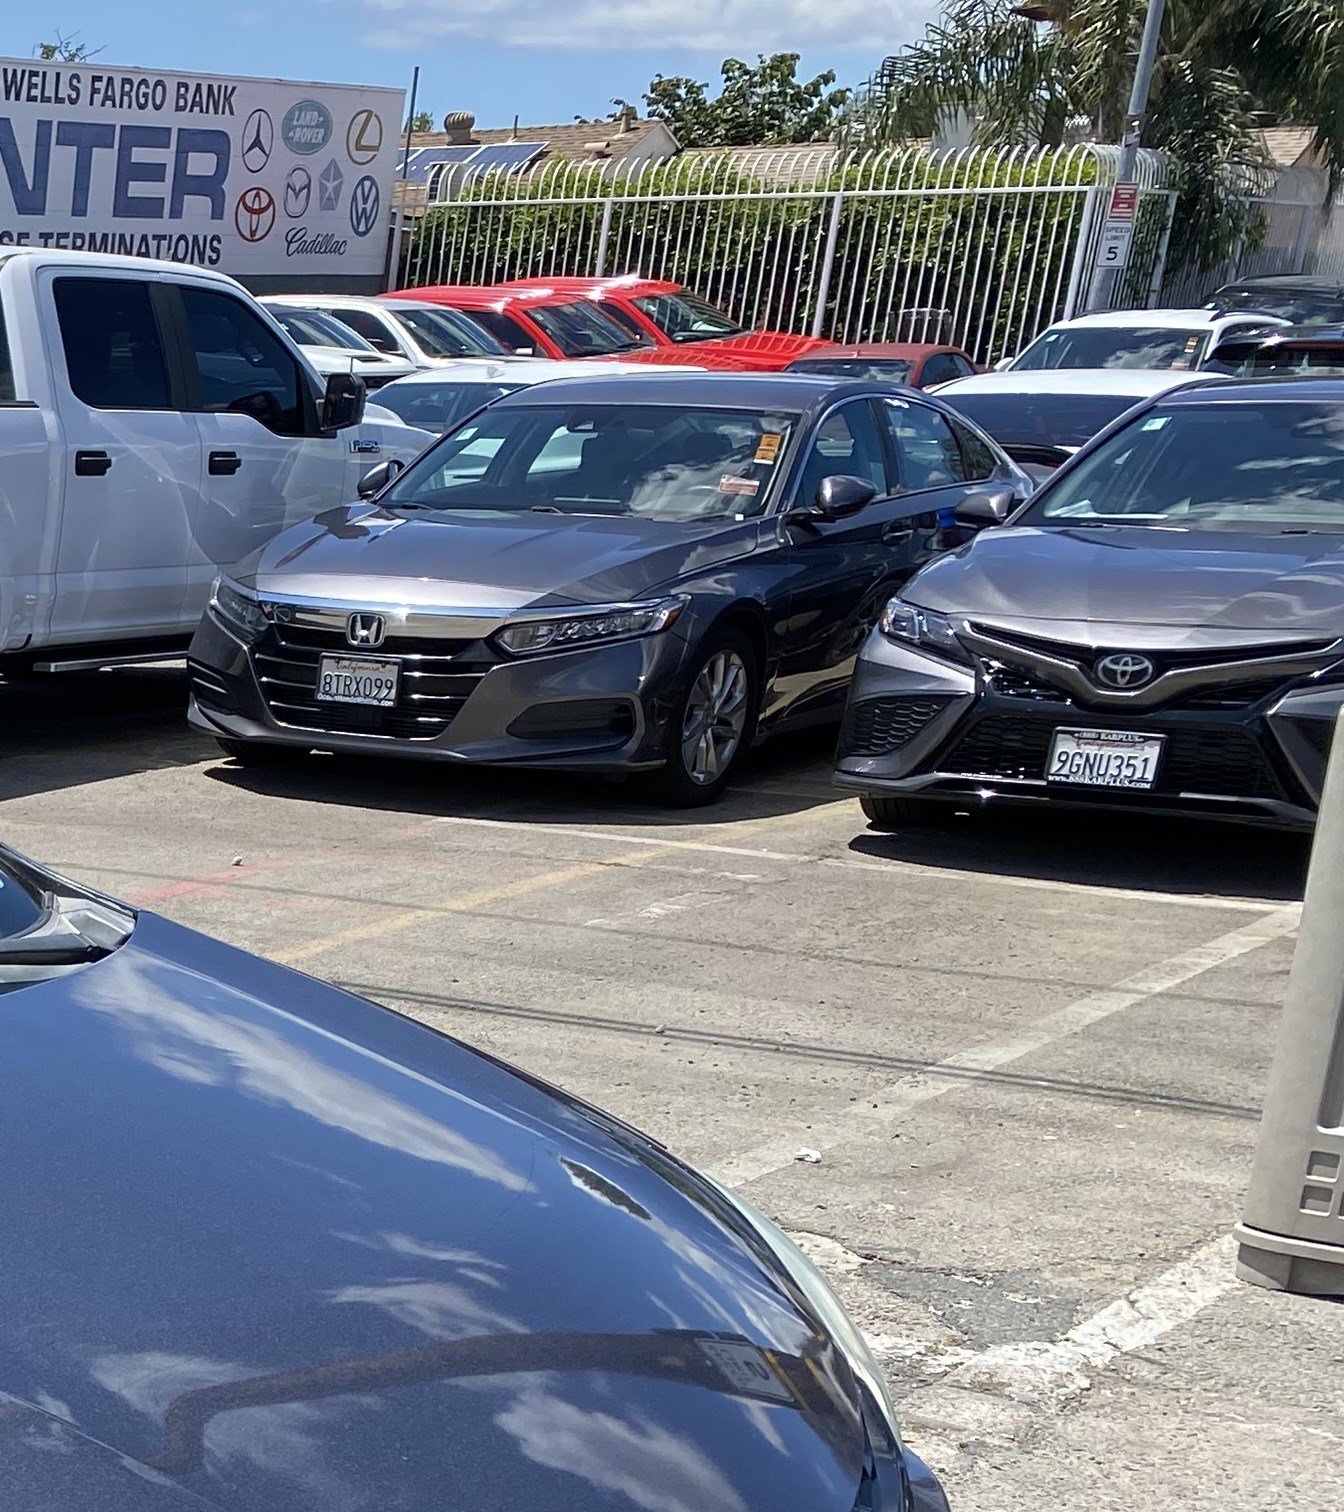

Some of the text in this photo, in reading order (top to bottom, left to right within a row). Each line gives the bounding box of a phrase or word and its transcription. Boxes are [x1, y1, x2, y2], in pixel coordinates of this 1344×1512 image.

[1, 67, 237, 117] WELLS FARGO BANK
[292, 110, 319, 126] LAND
[293, 127, 325, 143] ROVER
[285, 227, 347, 257] Cadillac
[1105, 246, 1119, 261] 5
[322, 673, 394, 699] 8TRX099
[1053, 750, 1150, 780] 9GNU351
